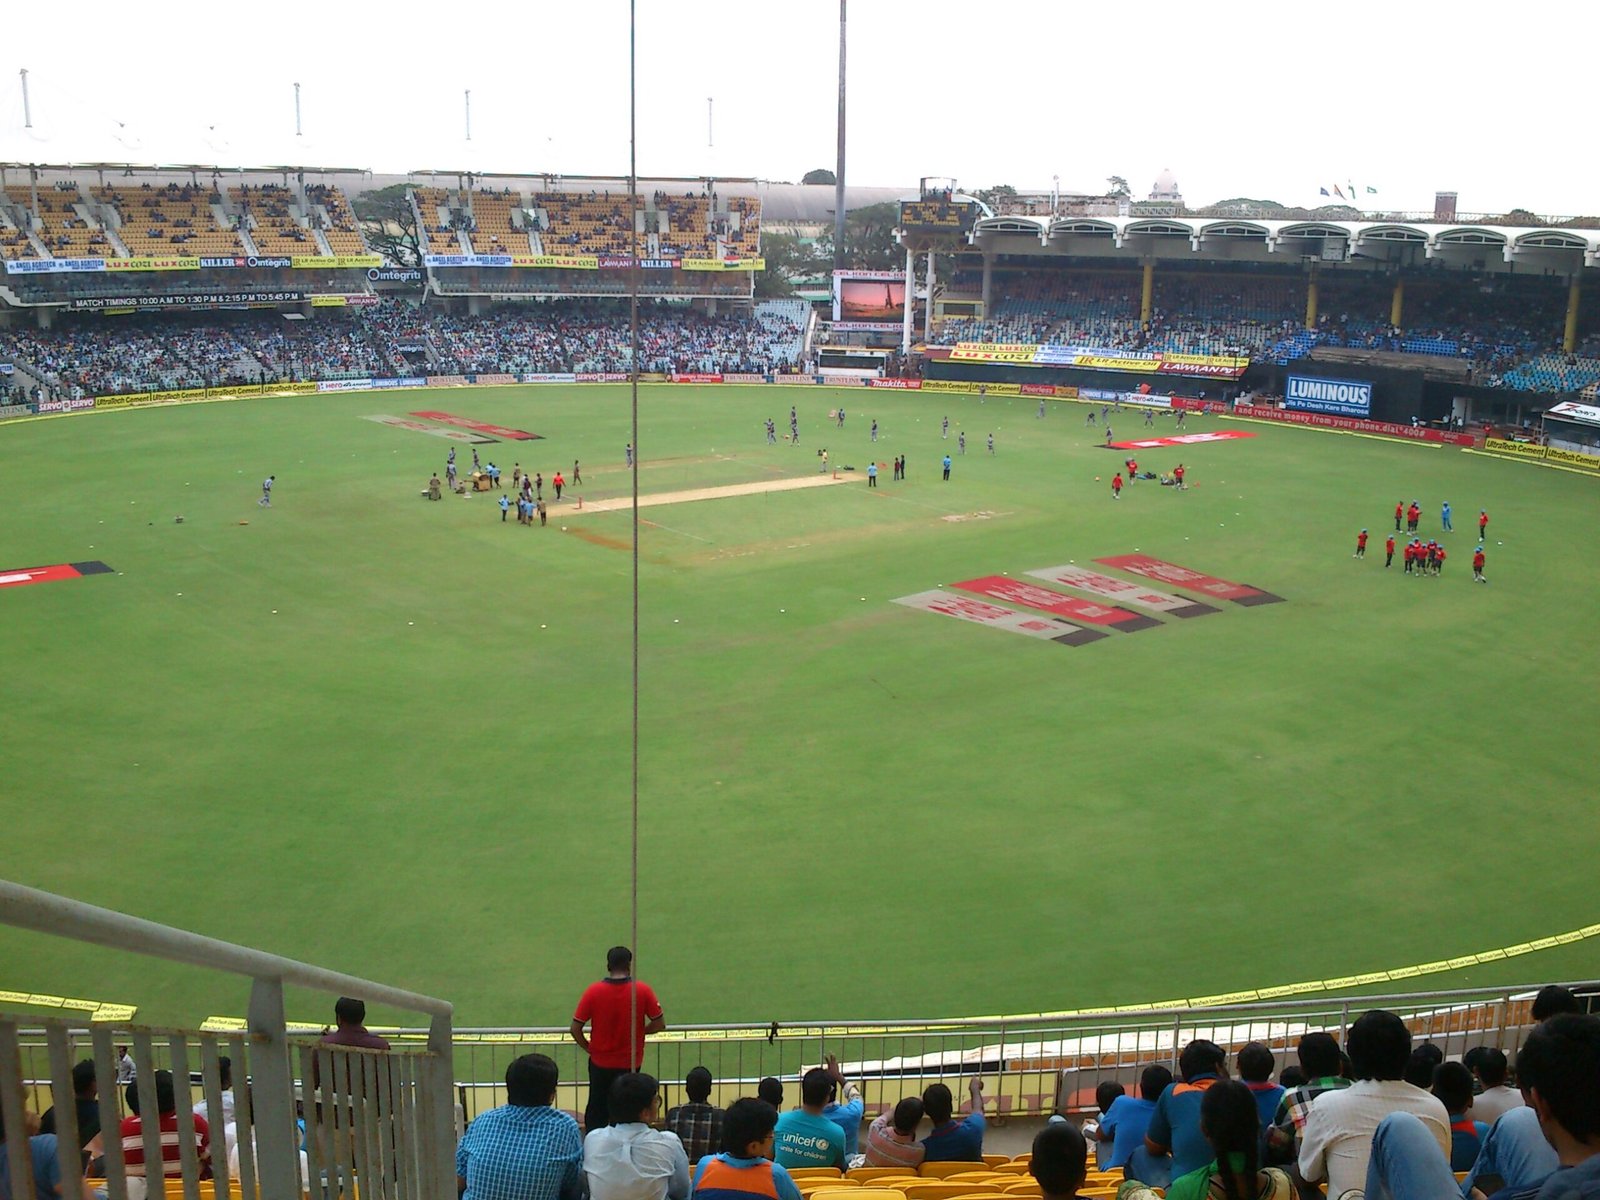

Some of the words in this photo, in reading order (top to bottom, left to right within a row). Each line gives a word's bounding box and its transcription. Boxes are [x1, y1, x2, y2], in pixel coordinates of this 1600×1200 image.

[201, 258, 235, 267] KILLER
[641, 260, 672, 268] KILLER
[76, 299, 104, 307] MATCH
[105, 298, 137, 307] TIMINGS
[174, 296, 186, 304] TO
[218, 295, 225, 303] &
[256, 294, 268, 302] TO
[953, 351, 993, 359] LUX
[1122, 352, 1154, 361] KILLER
[264, 385, 292, 393] UltraTech
[293, 383, 316, 391] Cement
[948, 382, 969, 390] Cement
[152, 392, 180, 401] UltraTech
[181, 391, 205, 399] Cement
[208, 388, 236, 397] UltraTech
[237, 387, 261, 395] Cement
[1290, 380, 1368, 405] LUMINOUS
[71, 399, 94, 408] SERVO
[96, 397, 125, 406] UltraTech
[126, 394, 149, 404] Cement
[39, 403, 63, 412] SERVO
[1287, 399, 1296, 407] Jis
[1325, 403, 1340, 411] Kare
[1341, 404, 1369, 415] Bharosa
[1238, 407, 1252, 415] and
[1254, 409, 1282, 418] receive
[1283, 414, 1310, 423] money
[1312, 416, 1331, 424] from
[1333, 419, 1352, 428] your
[1486, 440, 1517, 451] UltraTech
[1518, 444, 1544, 455] Cement
[1548, 449, 1575, 461] UltraTech
[1575, 454, 1600, 466] Cement
[782, 1133, 816, 1148] unicef
[803, 1151, 827, 1161] children
